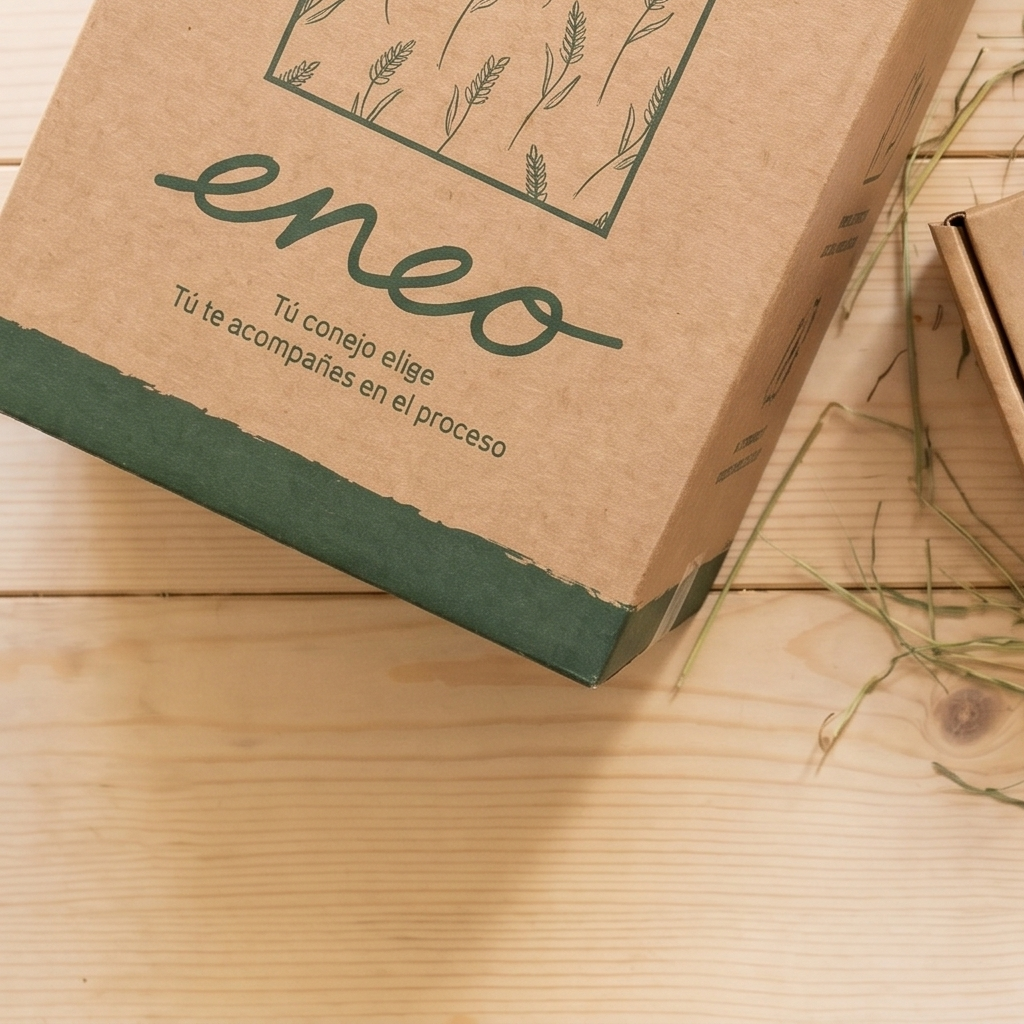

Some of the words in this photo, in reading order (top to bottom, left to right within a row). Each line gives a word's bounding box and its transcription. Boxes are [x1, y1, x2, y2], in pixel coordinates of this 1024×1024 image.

[154, 153, 623, 357] eneo
[273, 293, 300, 324] Tú
[302, 314, 377, 359] conejo
[381, 349, 435, 386] elige
[173, 284, 199, 315] Tú
[202, 300, 225, 327] te
[227, 317, 356, 388] acompañes
[359, 379, 388, 405] en
[391, 393, 416, 416] el
[413, 404, 507, 458] proceso
